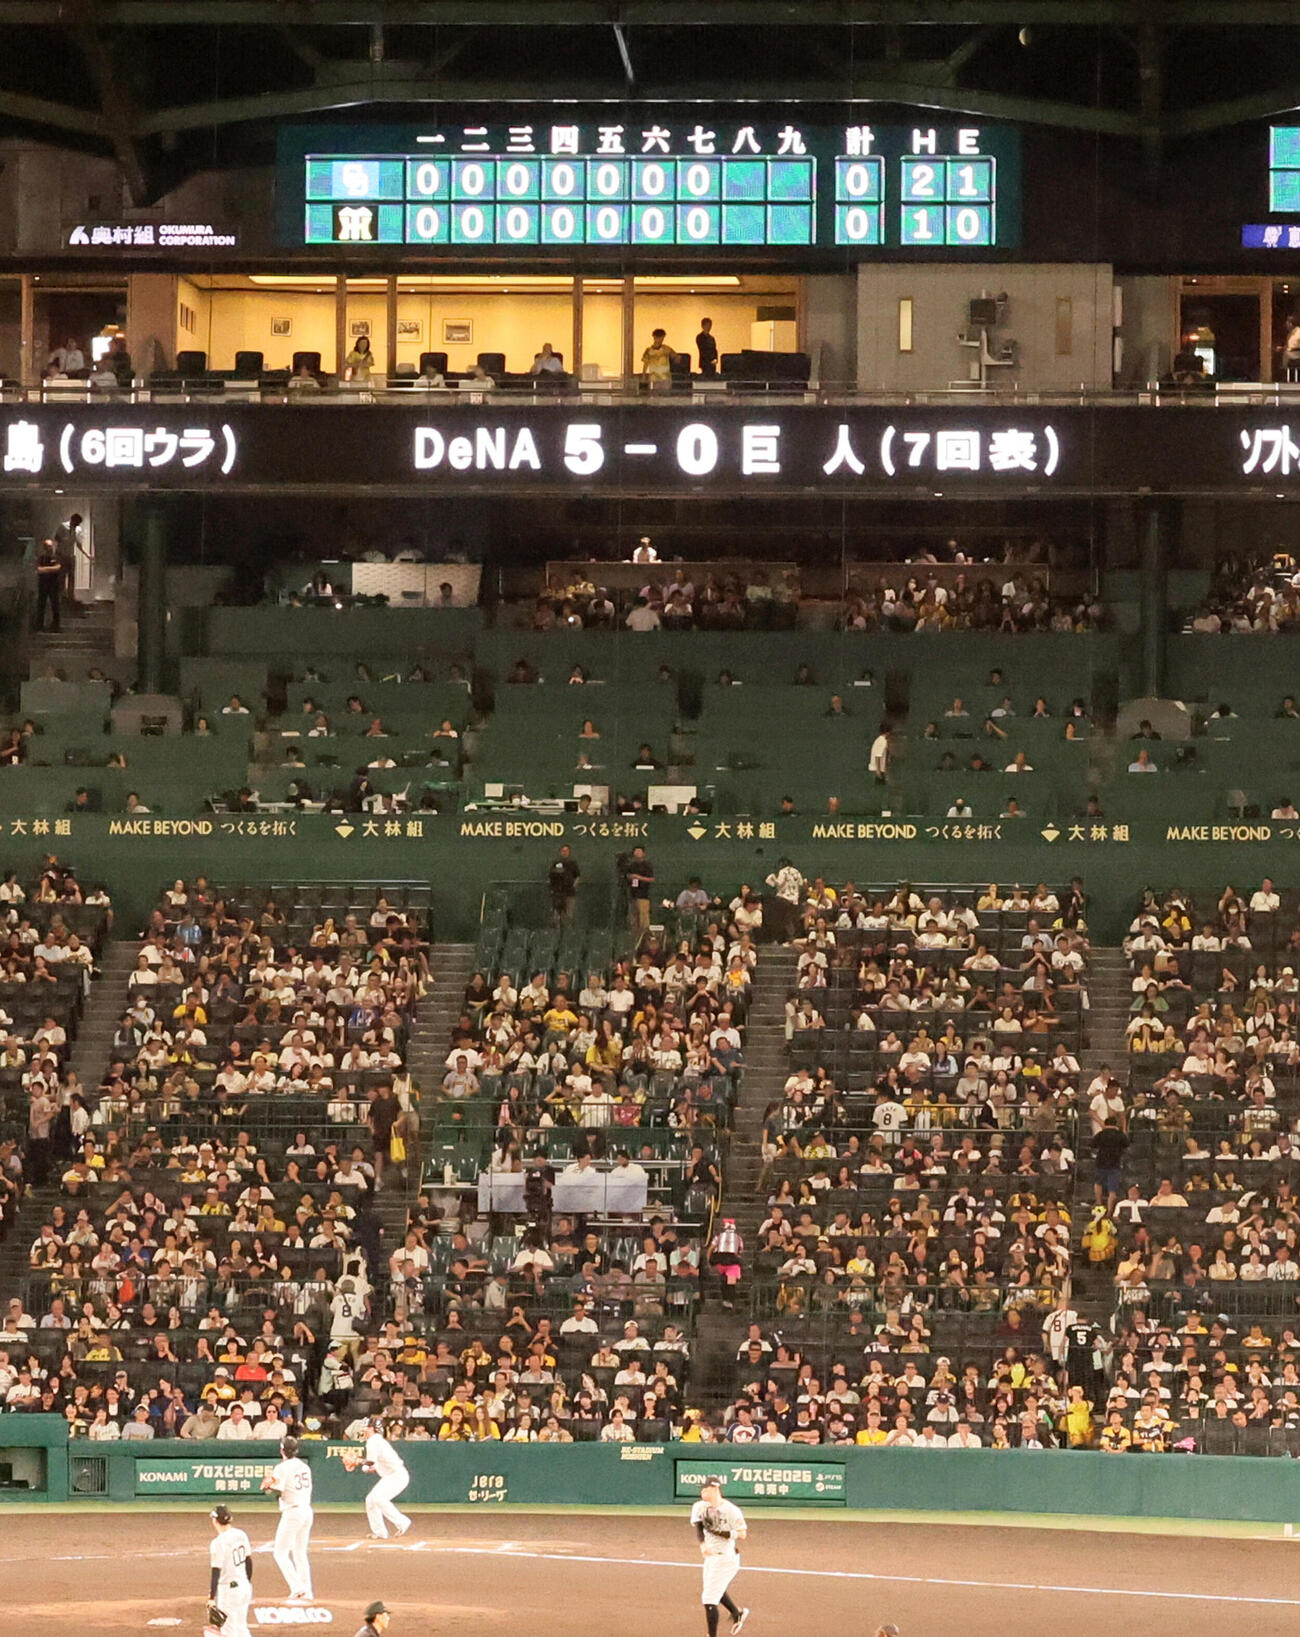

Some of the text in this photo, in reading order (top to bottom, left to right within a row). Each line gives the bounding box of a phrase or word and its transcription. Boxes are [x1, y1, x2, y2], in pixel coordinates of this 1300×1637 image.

[461, 127, 489, 151] 二
[507, 126, 535, 152] 三
[552, 126, 580, 154] 四
[597, 126, 625, 153] 五
[642, 126, 670, 153] 六
[687, 126, 715, 154] 七
[732, 127, 761, 153] 八
[778, 126, 806, 154] 九
[846, 126, 874, 156] 計
[913, 129, 936, 154] H
[958, 129, 979, 154] E
[416, 163, 978, 196] 0 0 0 0 0 0 0 0 2 1
[159, 225, 214, 235] OKUMURA
[416, 207, 439, 239] 0
[461, 207, 484, 239] 0
[506, 207, 529, 239] 0
[551, 207, 574, 239] 0
[597, 207, 619, 239] 0
[642, 207, 664, 239] 0
[687, 207, 709, 239] 0
[845, 208, 868, 240] 0
[913, 209, 933, 239] 1
[957, 209, 980, 240] 0
[159, 236, 236, 246] CORPORATION
[414, 426, 541, 470] DeNA
[563, 424, 605, 475] 5
[676, 424, 719, 475] 0
[109, 820, 151, 835] MAKE
[153, 820, 213, 835] BEYOND
[460, 821, 503, 837] MAKE
[505, 821, 564, 837] BEYOND
[812, 823, 855, 839] MAKE
[857, 823, 917, 839] BEYOND
[1166, 825, 1209, 841] MAKE
[1211, 825, 1271, 841] BEYOND
[883, 1112, 892, 1126] 8
[1076, 1331, 1087, 1346] 5
[139, 1472, 188, 1482] KONAMI
[294, 1472, 310, 1491] 35
[731, 1467, 812, 1483] プロスピ2026
